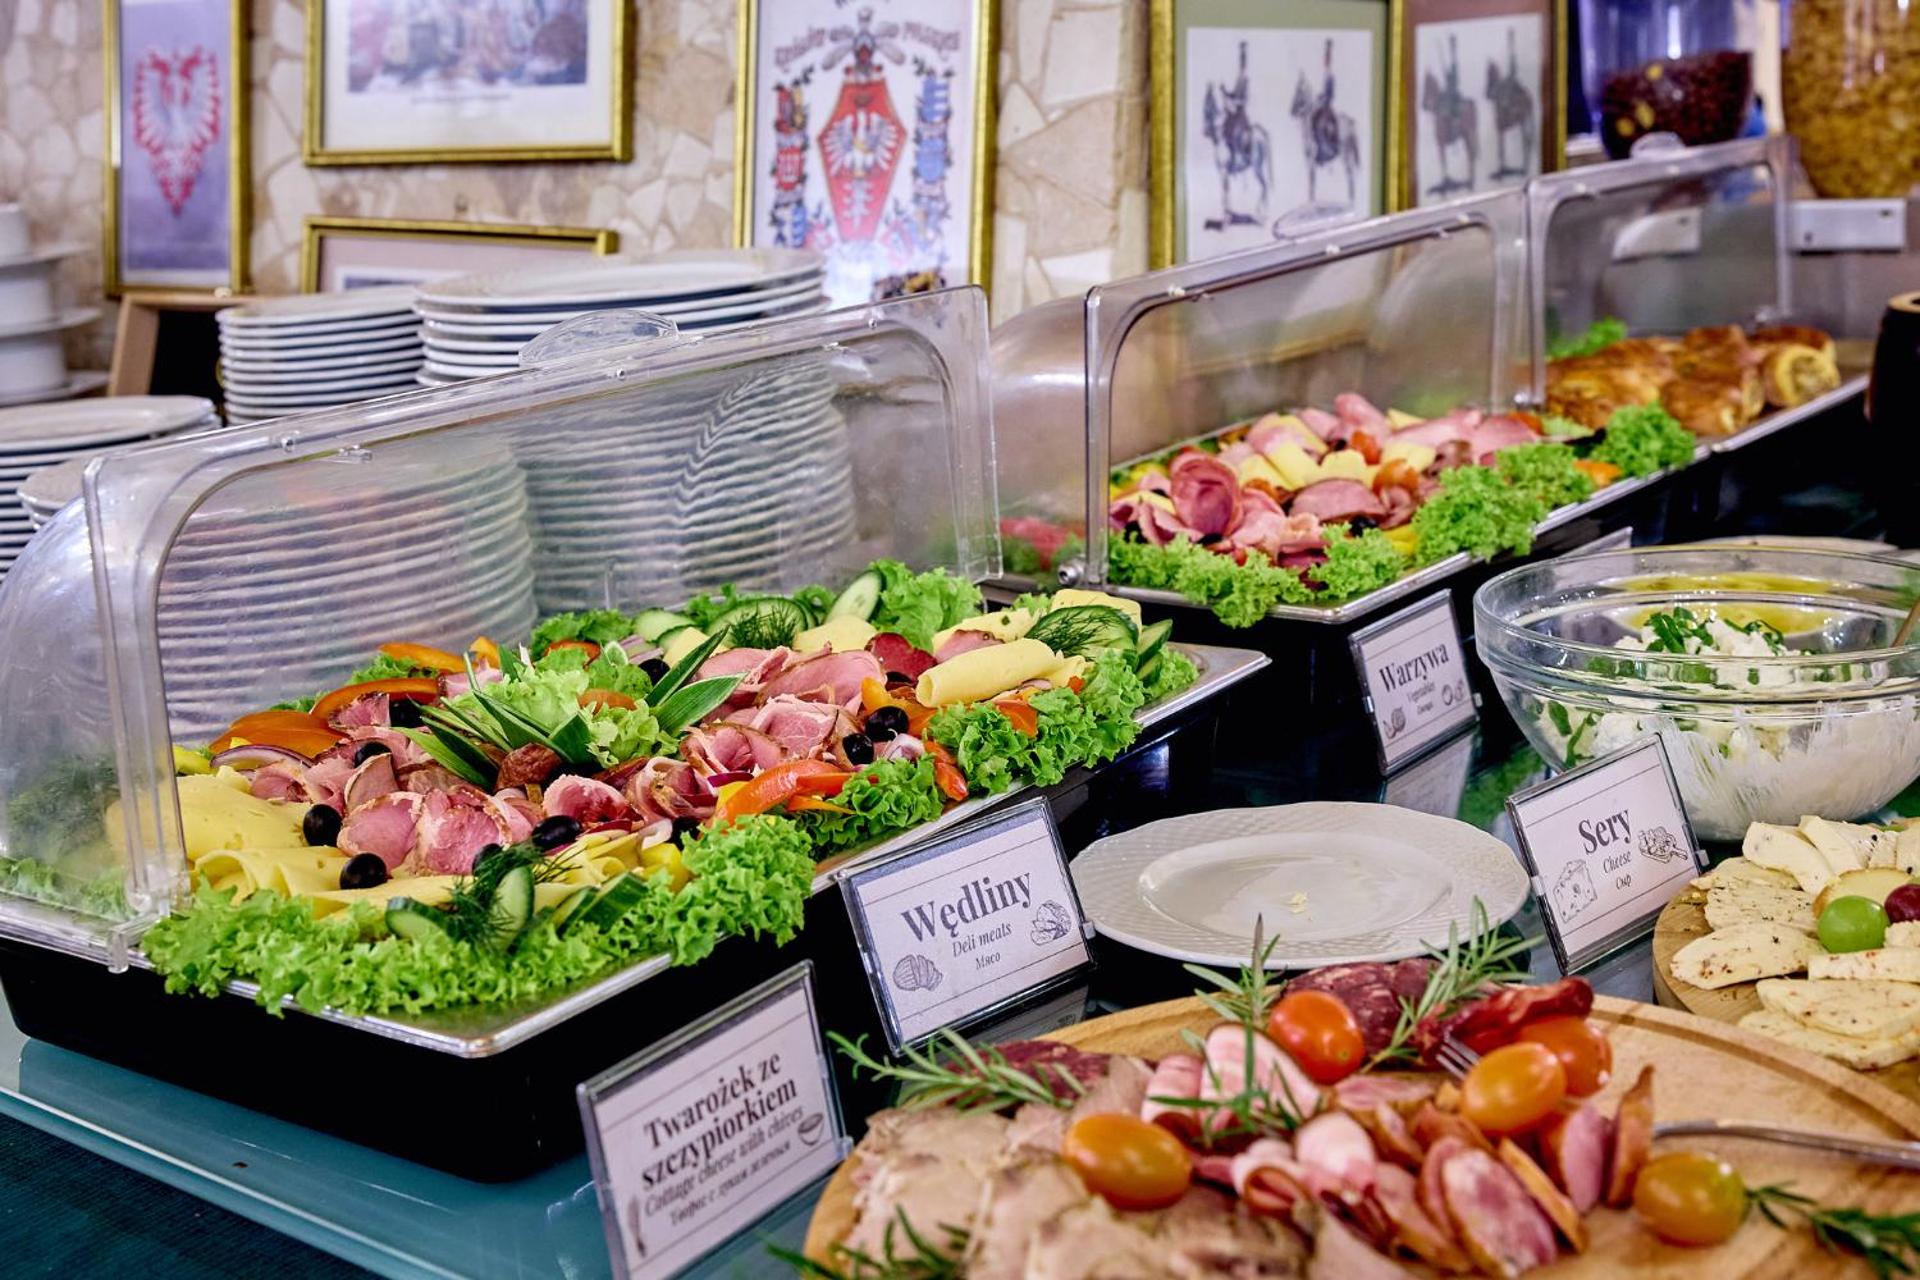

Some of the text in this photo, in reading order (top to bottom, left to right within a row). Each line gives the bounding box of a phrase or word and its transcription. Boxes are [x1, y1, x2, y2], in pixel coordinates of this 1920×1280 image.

[1379, 644, 1449, 692] Warzywa
[1578, 809, 1631, 855] Sery
[1603, 851, 1631, 873] Cheese
[901, 872, 1031, 942] Wędliny
[952, 922, 1012, 957] Deli meats
[643, 1053, 781, 1149] Twarożek ze
[642, 1079, 798, 1187] szczypiorkiem
